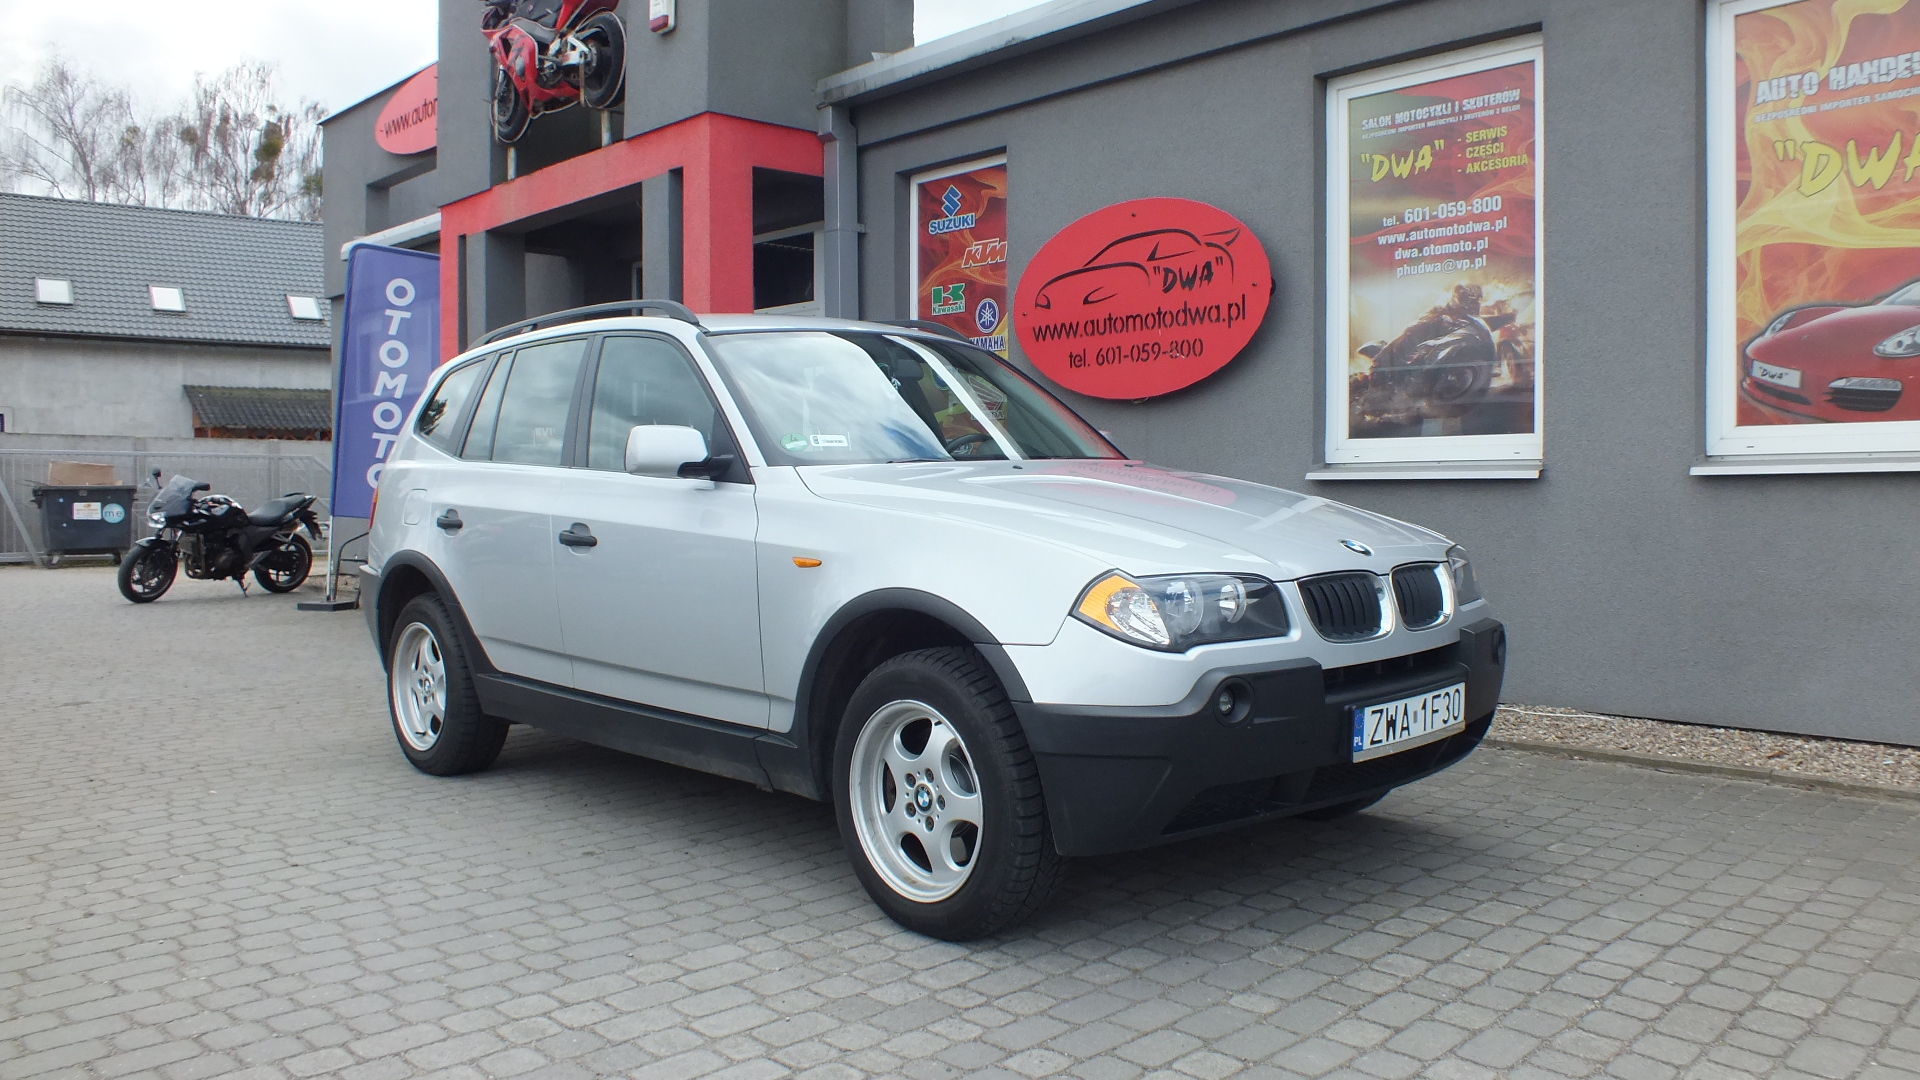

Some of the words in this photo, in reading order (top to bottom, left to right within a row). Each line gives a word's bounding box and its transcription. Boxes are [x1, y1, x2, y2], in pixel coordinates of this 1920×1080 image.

[1755, 72, 1819, 105] AUTO
[1821, 95, 1870, 111] IMPORTER
[1362, 114, 1391, 130] SALON
[1394, 102, 1451, 125] MOTOCYKLI
[1454, 101, 1459, 113] I
[1462, 86, 1520, 111] SKUTERÓW
[1465, 126, 1508, 143] SERWIS
[1361, 139, 1445, 183] "DWA"
[1465, 141, 1504, 159] CZĘŚCI
[1465, 154, 1529, 174] AKCESORIA
[929, 212, 976, 235] SUZUKI
[1383, 215, 1400, 227] tel.
[1404, 195, 1502, 224] 601-059-800
[1378, 216, 1508, 246] www.automotodwa.pl
[962, 238, 1007, 268] KTM
[1395, 236, 1489, 260] dwa.otomoto.pl
[1153, 256, 1224, 293] "DWA"
[1396, 255, 1487, 279] phudwa@vp.pl
[932, 301, 965, 315] Kawasaki
[1033, 294, 1246, 342] www.automotodwa.pl
[1069, 349, 1090, 369] tel.
[1096, 338, 1204, 366] 601-059-800
[1370, 703, 1410, 745] ZWA
[1421, 688, 1460, 731] 1F30
[1354, 736, 1363, 747] PL
